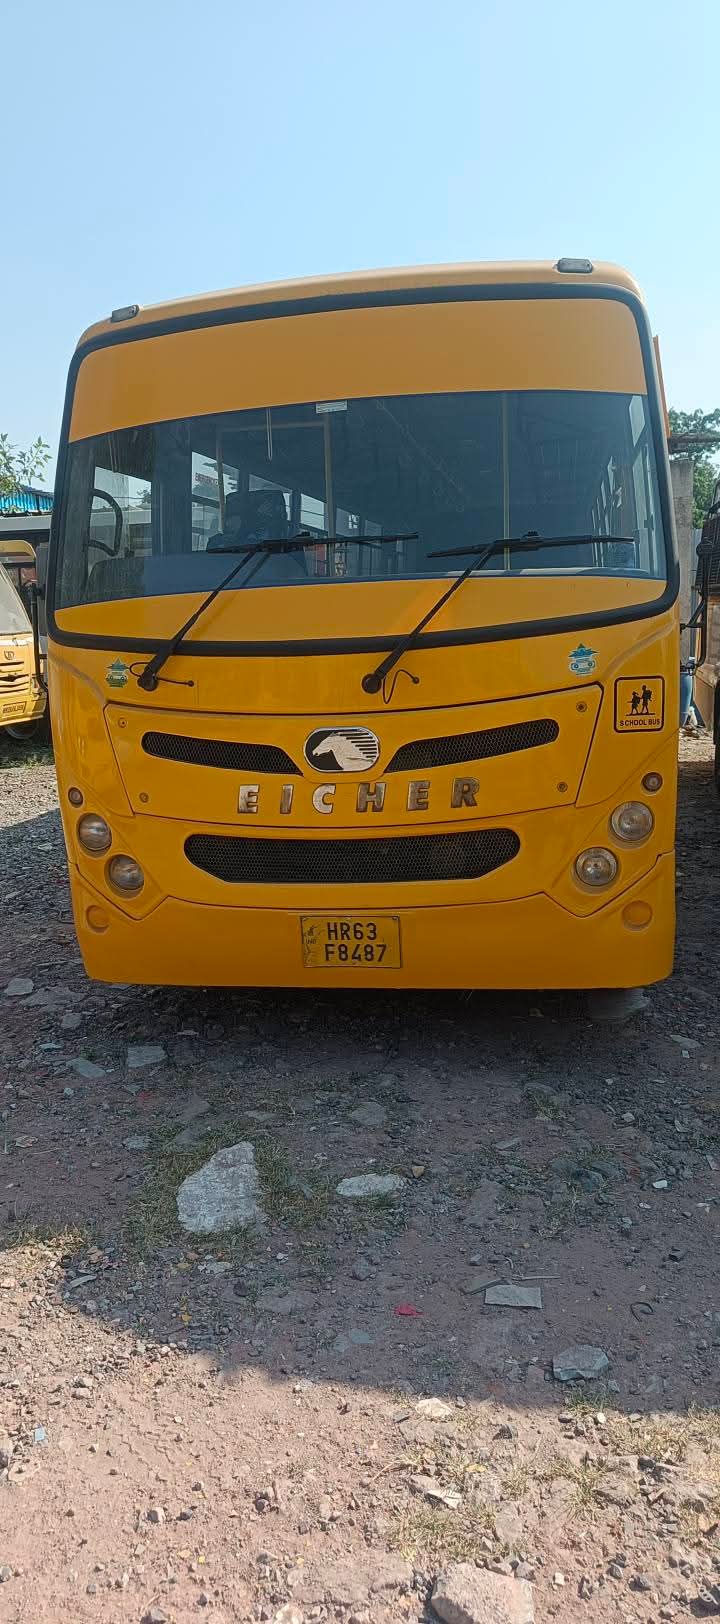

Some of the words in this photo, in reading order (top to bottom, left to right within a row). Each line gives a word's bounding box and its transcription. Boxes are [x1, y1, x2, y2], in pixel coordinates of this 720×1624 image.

[619, 719, 647, 727] SCHOOL
[648, 718, 661, 726] BUS
[237, 776, 481, 815] EICHER
[327, 922, 378, 941] HR63
[325, 943, 387, 962] F8487
